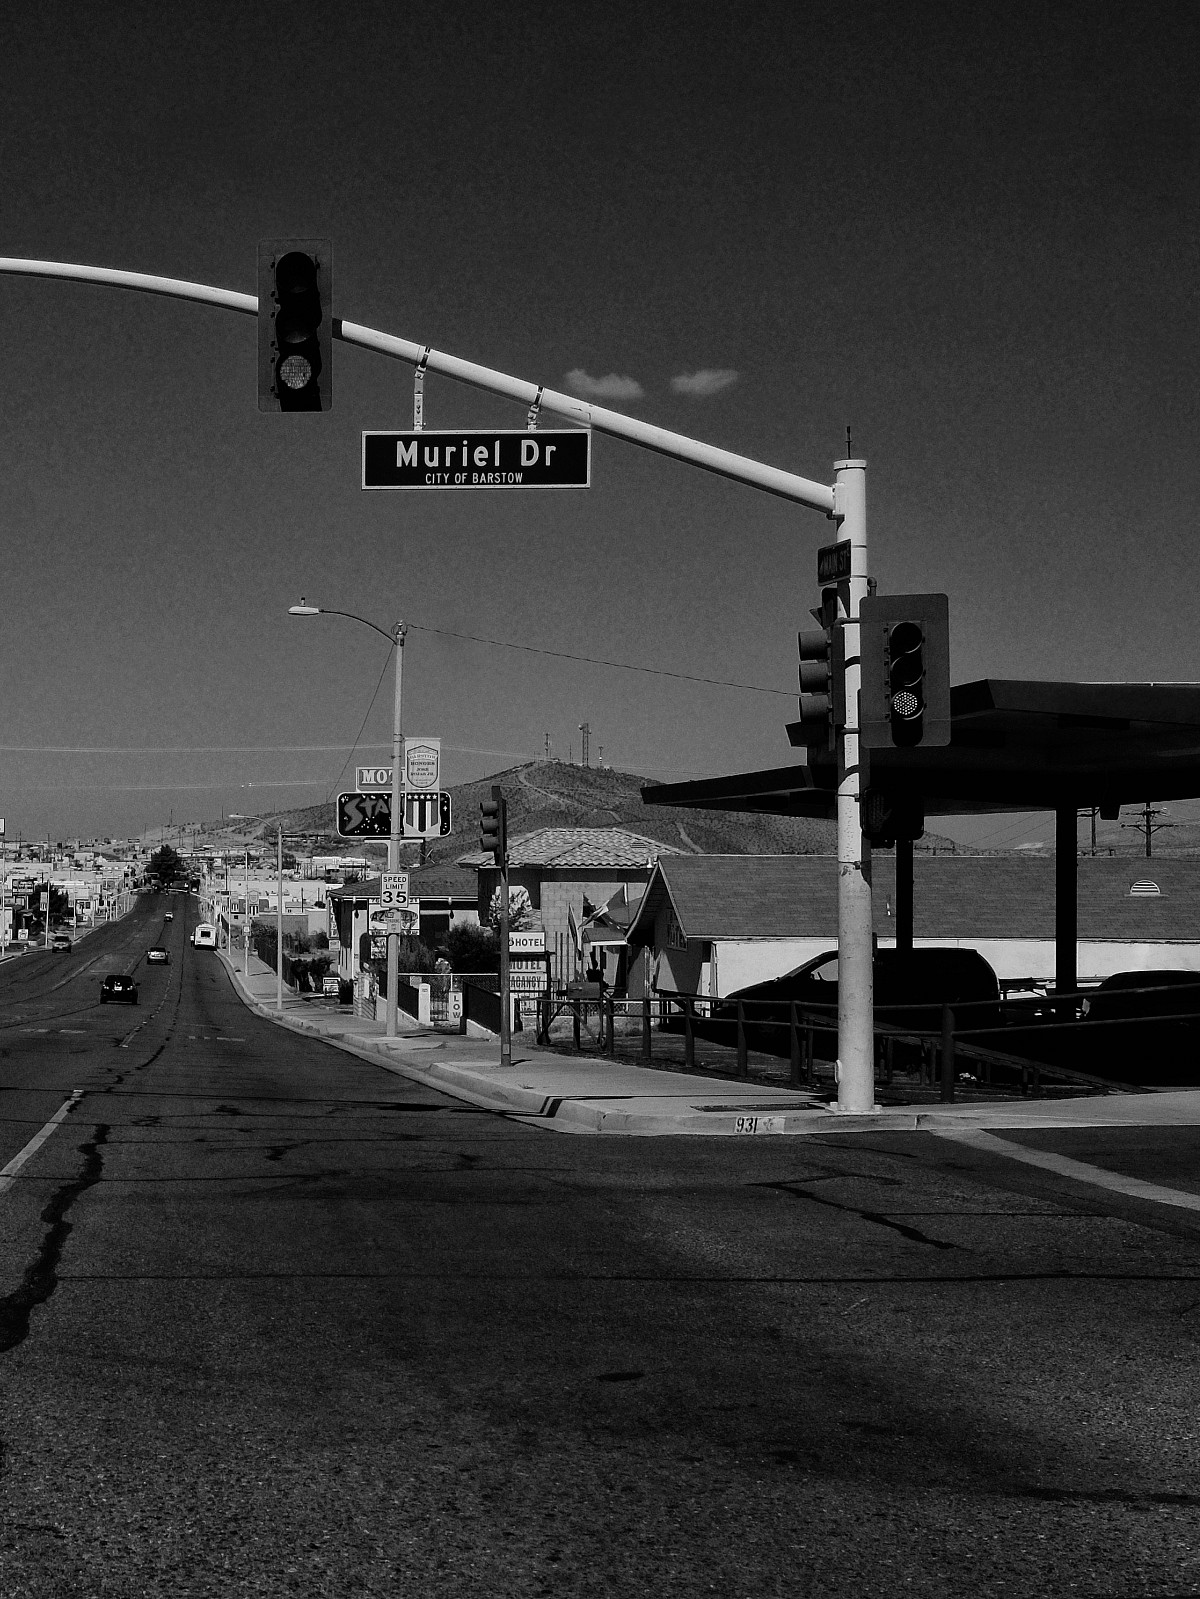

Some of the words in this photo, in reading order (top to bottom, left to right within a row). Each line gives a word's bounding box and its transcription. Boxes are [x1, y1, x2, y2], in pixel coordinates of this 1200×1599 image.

[396, 440, 500, 467] Muriel
[520, 439, 557, 467] Dr
[425, 473, 450, 484] CITY
[454, 473, 467, 484] OF
[472, 472, 523, 483] BARSTOW
[382, 890, 407, 904] 35
[515, 938, 545, 947] HOTEL
[509, 976, 542, 988] ACANCY
[452, 995, 461, 1018] LOW
[736, 1117, 757, 1133] 931
